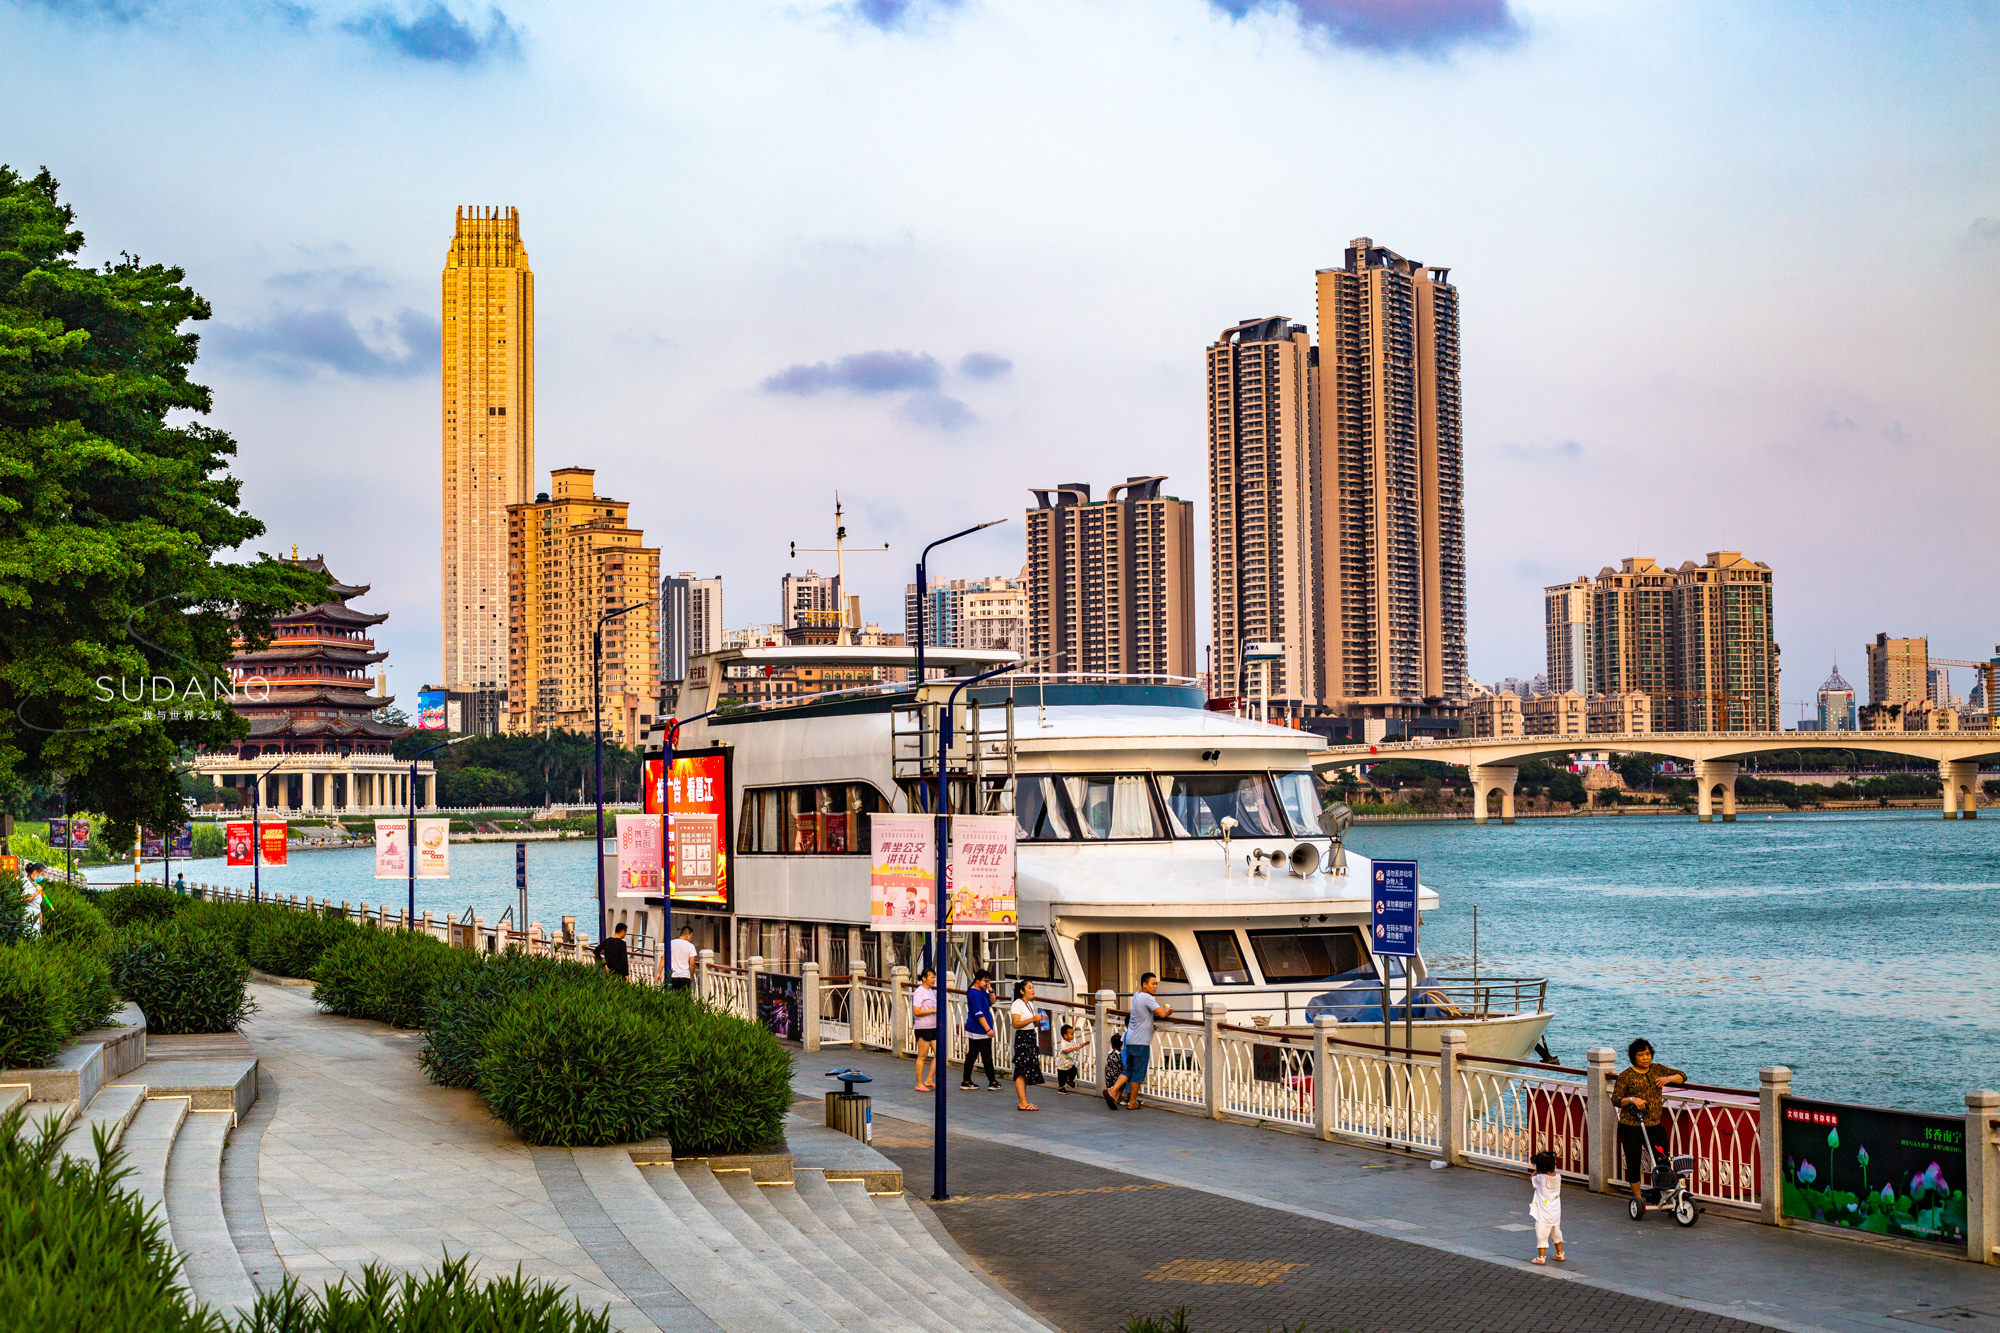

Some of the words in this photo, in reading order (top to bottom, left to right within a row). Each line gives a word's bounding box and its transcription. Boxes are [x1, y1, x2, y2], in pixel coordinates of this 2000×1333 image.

[687, 776, 713, 803] 看邕江
[880, 842, 926, 853] 乘坐公交
[961, 843, 1008, 855] 有序排队
[886, 853, 920, 864] 讲礼让
[967, 854, 1002, 865] 讲礼让
[1924, 1127, 1962, 1144] 书香南宁
